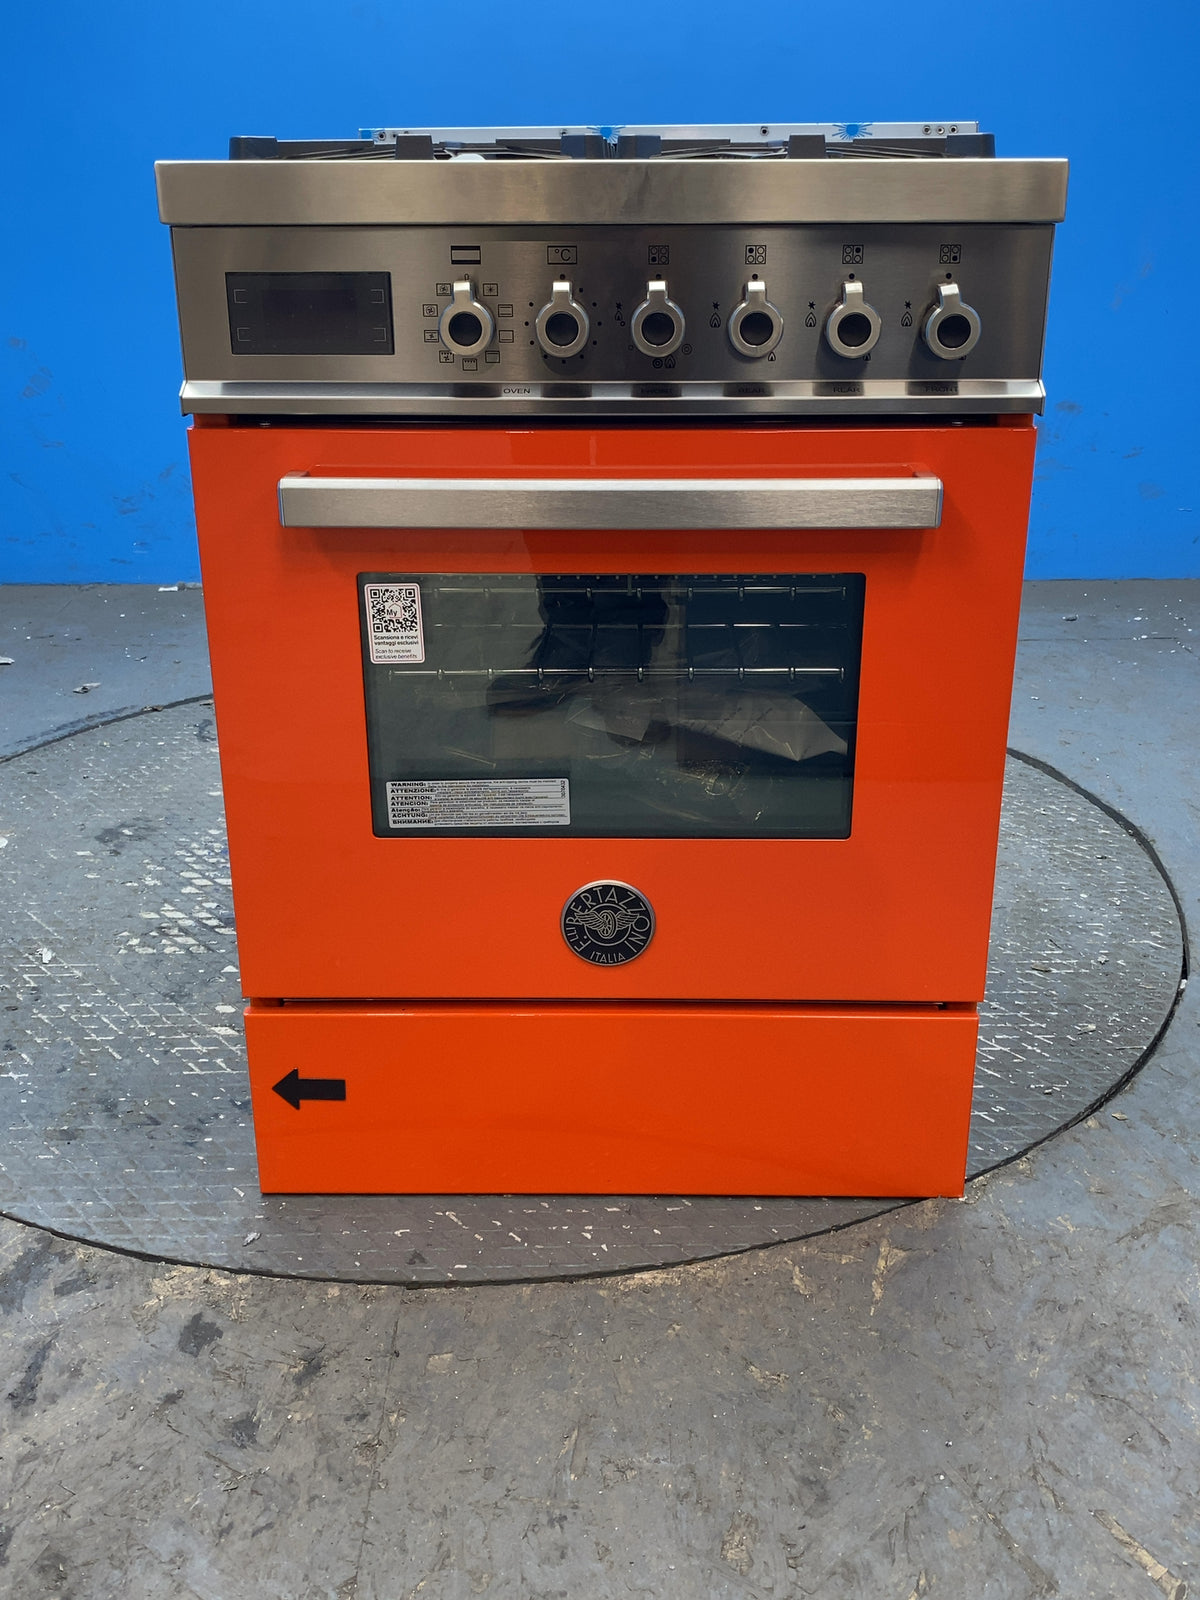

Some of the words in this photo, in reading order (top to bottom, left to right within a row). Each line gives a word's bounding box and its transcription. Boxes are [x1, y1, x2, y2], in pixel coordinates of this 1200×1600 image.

[555, 249, 570, 261] °C
[386, 609, 398, 617] My
[565, 886, 651, 953] BERTAZZONI
[590, 951, 626, 963] ITALIA
